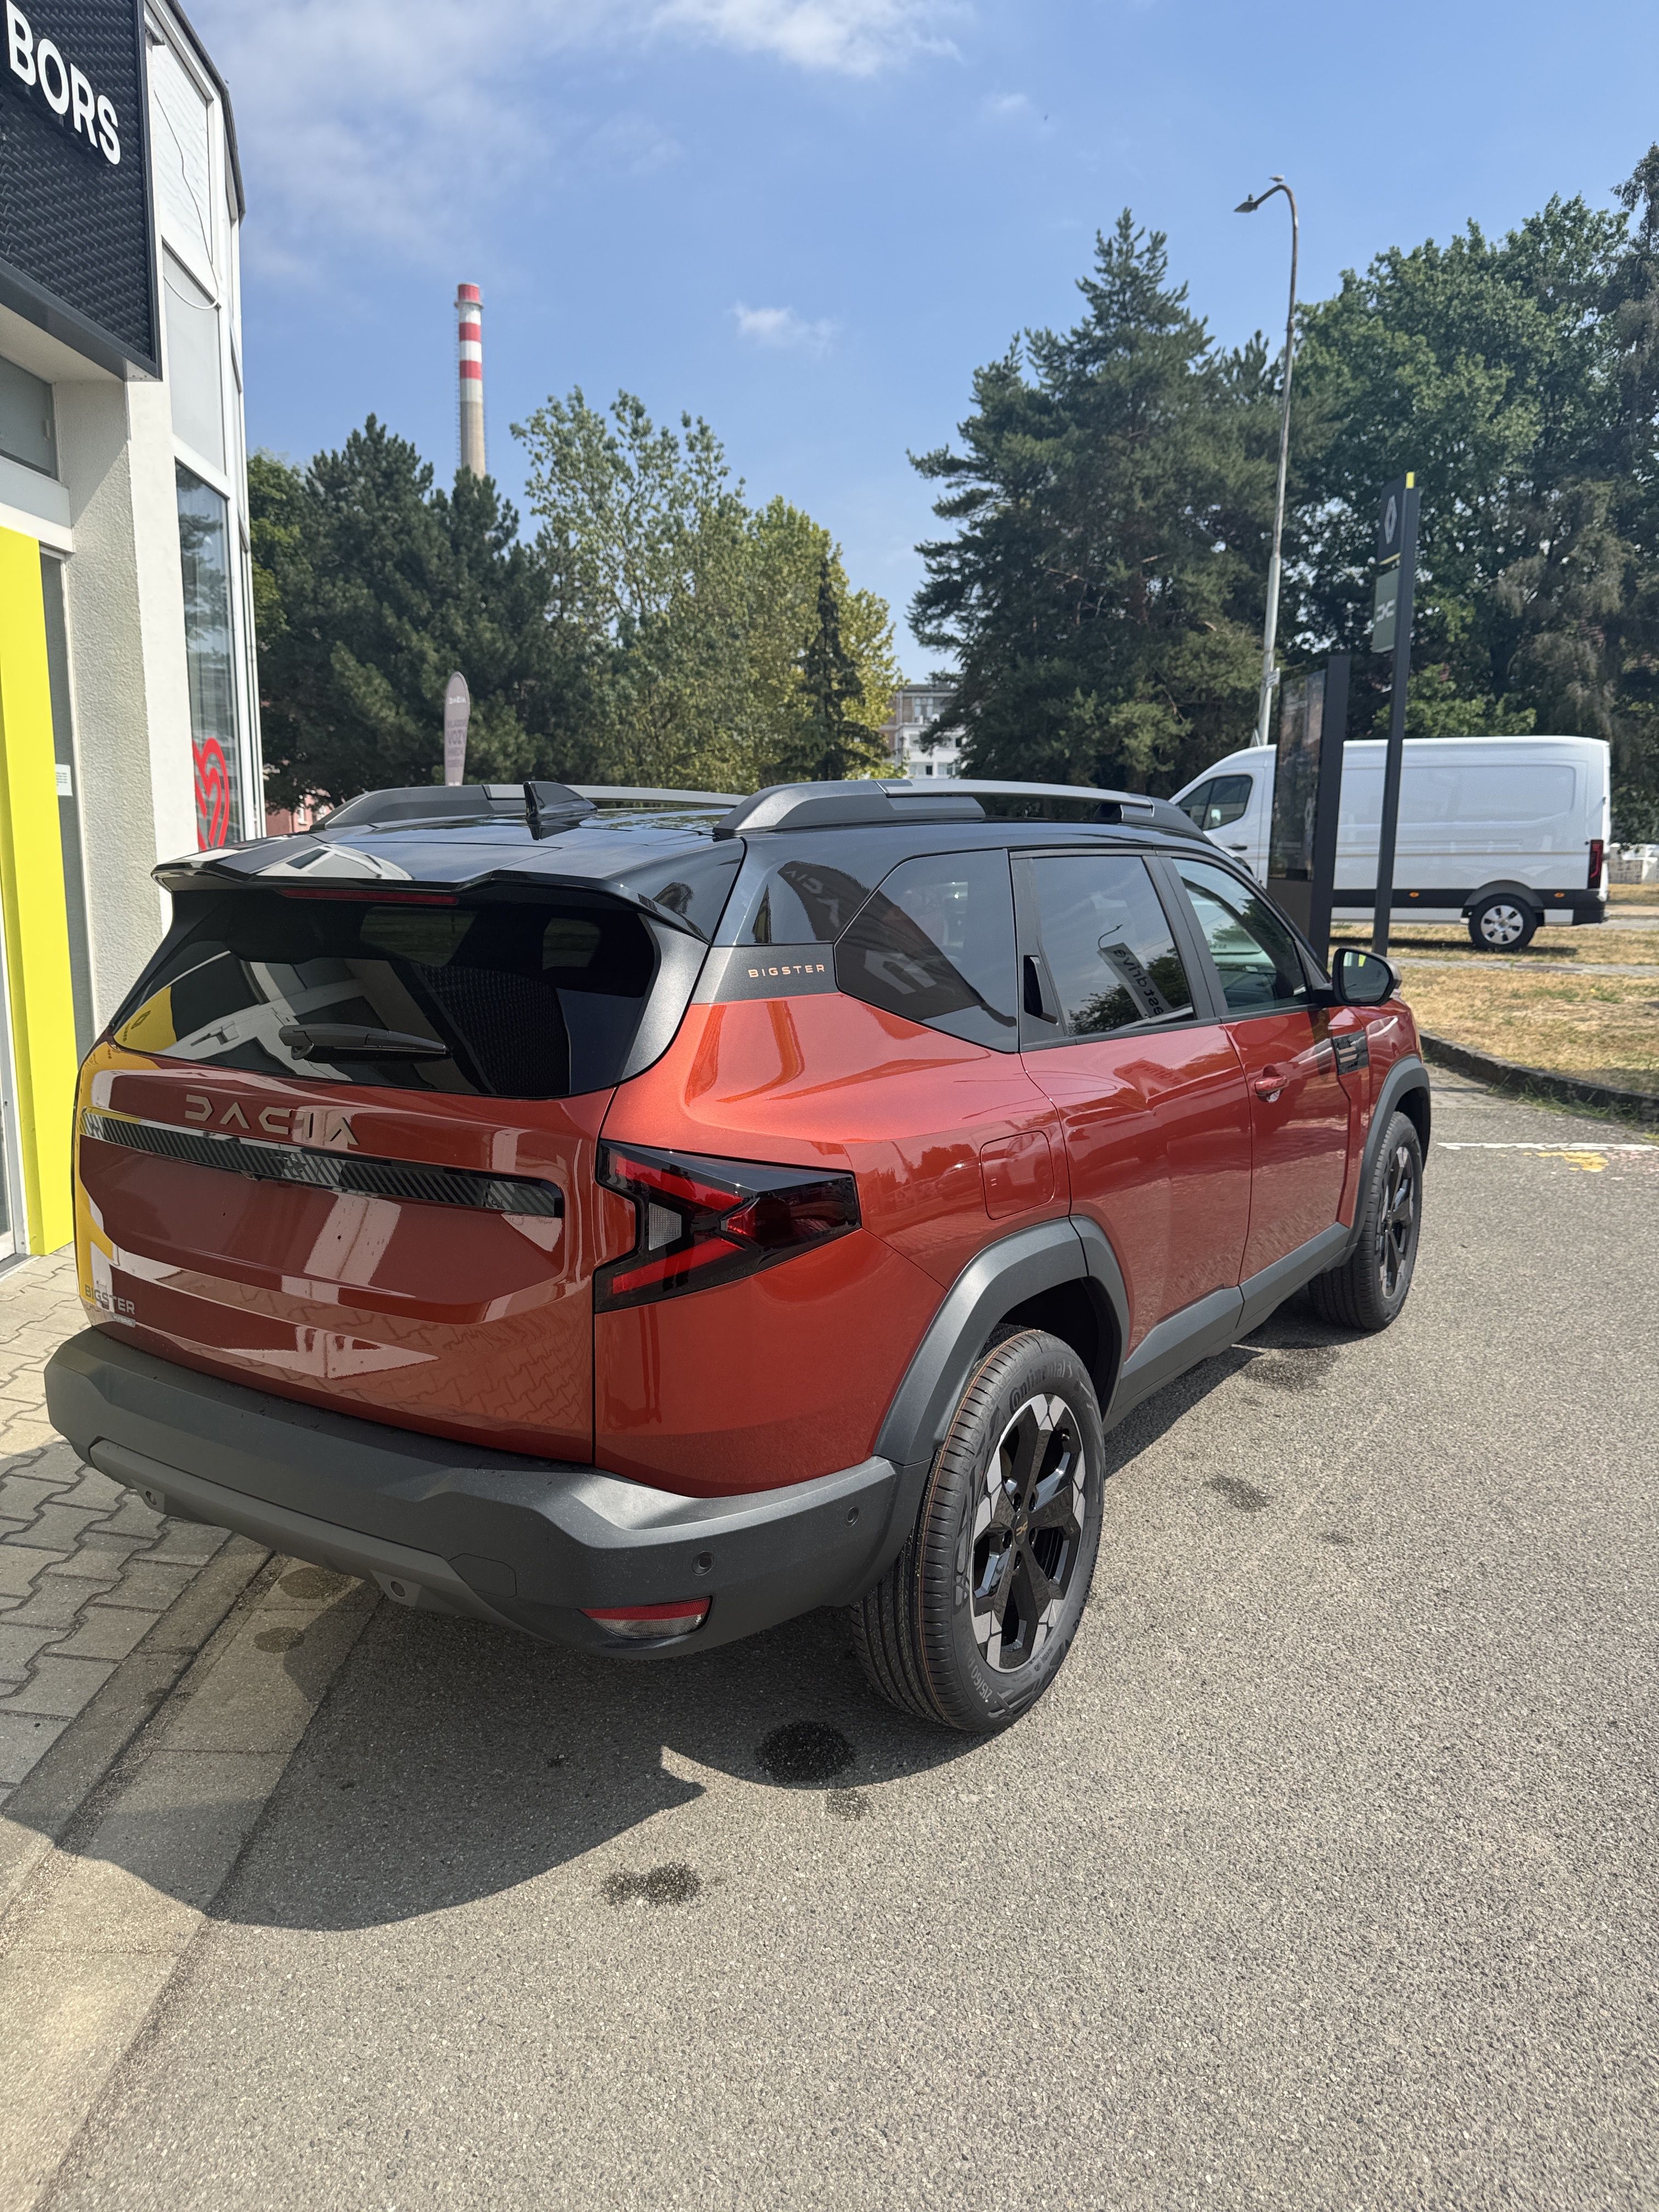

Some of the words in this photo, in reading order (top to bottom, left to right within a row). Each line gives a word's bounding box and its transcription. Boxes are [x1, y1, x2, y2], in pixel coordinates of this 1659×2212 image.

[6, 0, 121, 165] BORS
[748, 964, 825, 978] BIGSTER
[184, 1094, 359, 1145] DACIA
[85, 1284, 135, 1314] BIGSTER
